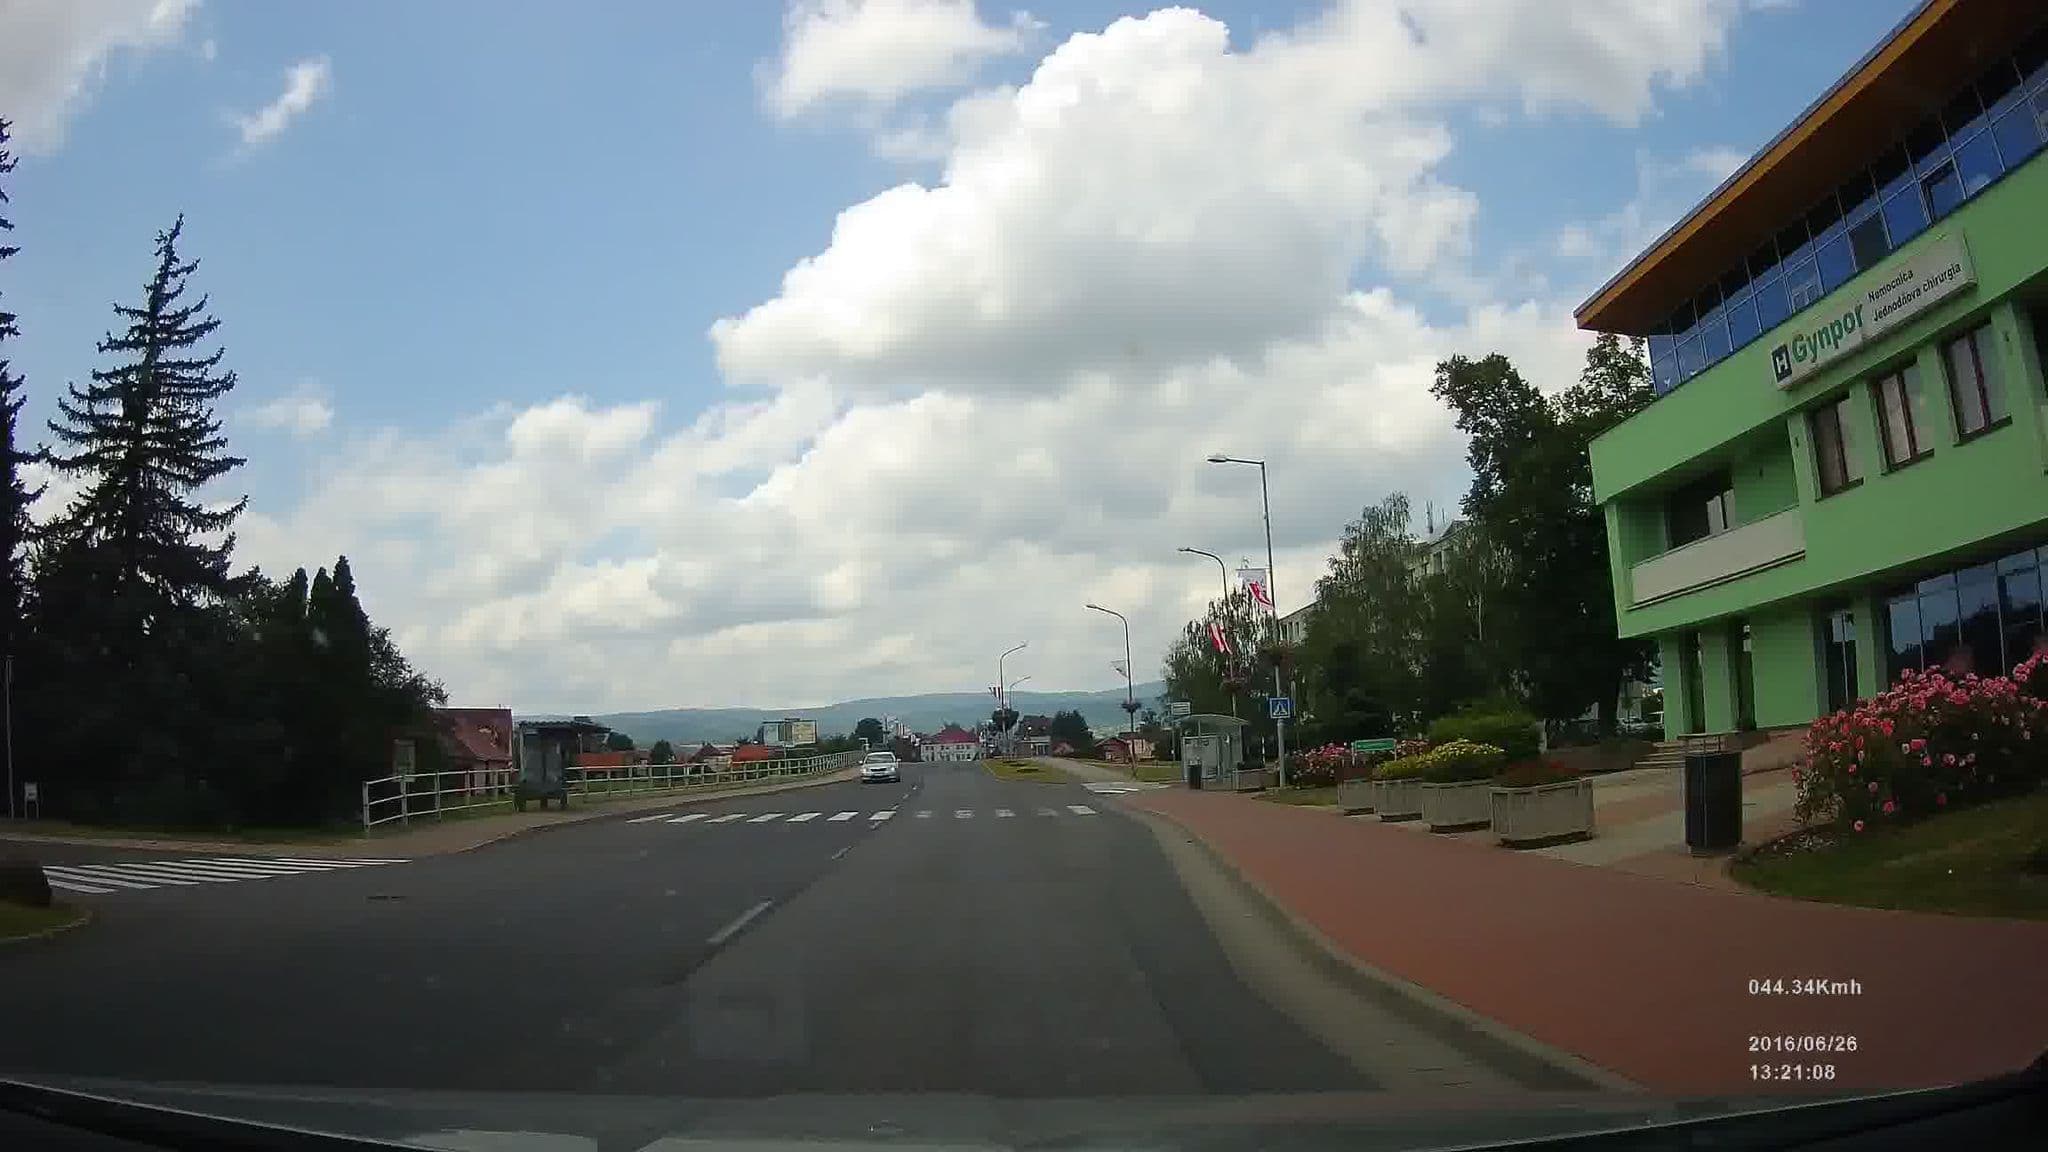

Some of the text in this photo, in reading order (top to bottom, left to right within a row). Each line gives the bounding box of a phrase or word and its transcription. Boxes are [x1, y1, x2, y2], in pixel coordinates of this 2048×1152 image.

[1868, 269, 1914, 303] Nemocnica
[1923, 263, 1961, 292] chirurgia
[1792, 304, 1863, 362] Gynpor
